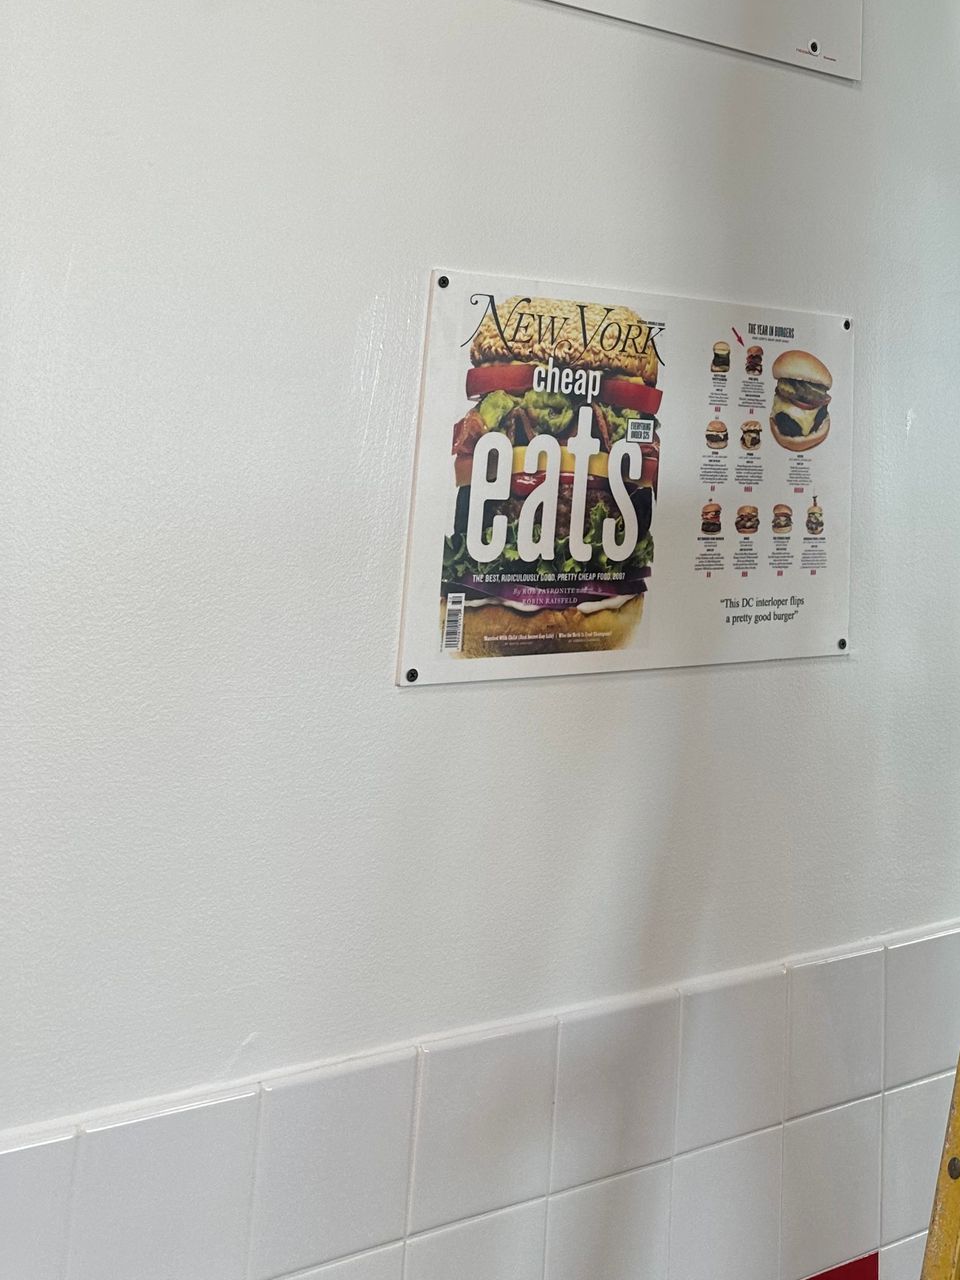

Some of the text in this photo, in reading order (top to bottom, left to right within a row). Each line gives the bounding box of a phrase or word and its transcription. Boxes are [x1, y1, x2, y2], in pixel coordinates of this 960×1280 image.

[460, 293, 666, 367] NEW YORK
[757, 324, 768, 335] YEAR
[774, 326, 794, 339] BURGERS
[533, 357, 601, 404] cheap
[466, 406, 642, 562] eats
[472, 574, 484, 583] THE
[501, 574, 539, 582] RIDICULOUSLY
[557, 573, 578, 581] PRETTY
[578, 572, 596, 581] CHEAP
[742, 597, 754, 607] DC
[756, 597, 788, 609] interloper
[790, 596, 804, 608] flips
[726, 615, 730, 623] a
[732, 614, 752, 625] pretty
[754, 612, 771, 624] good
